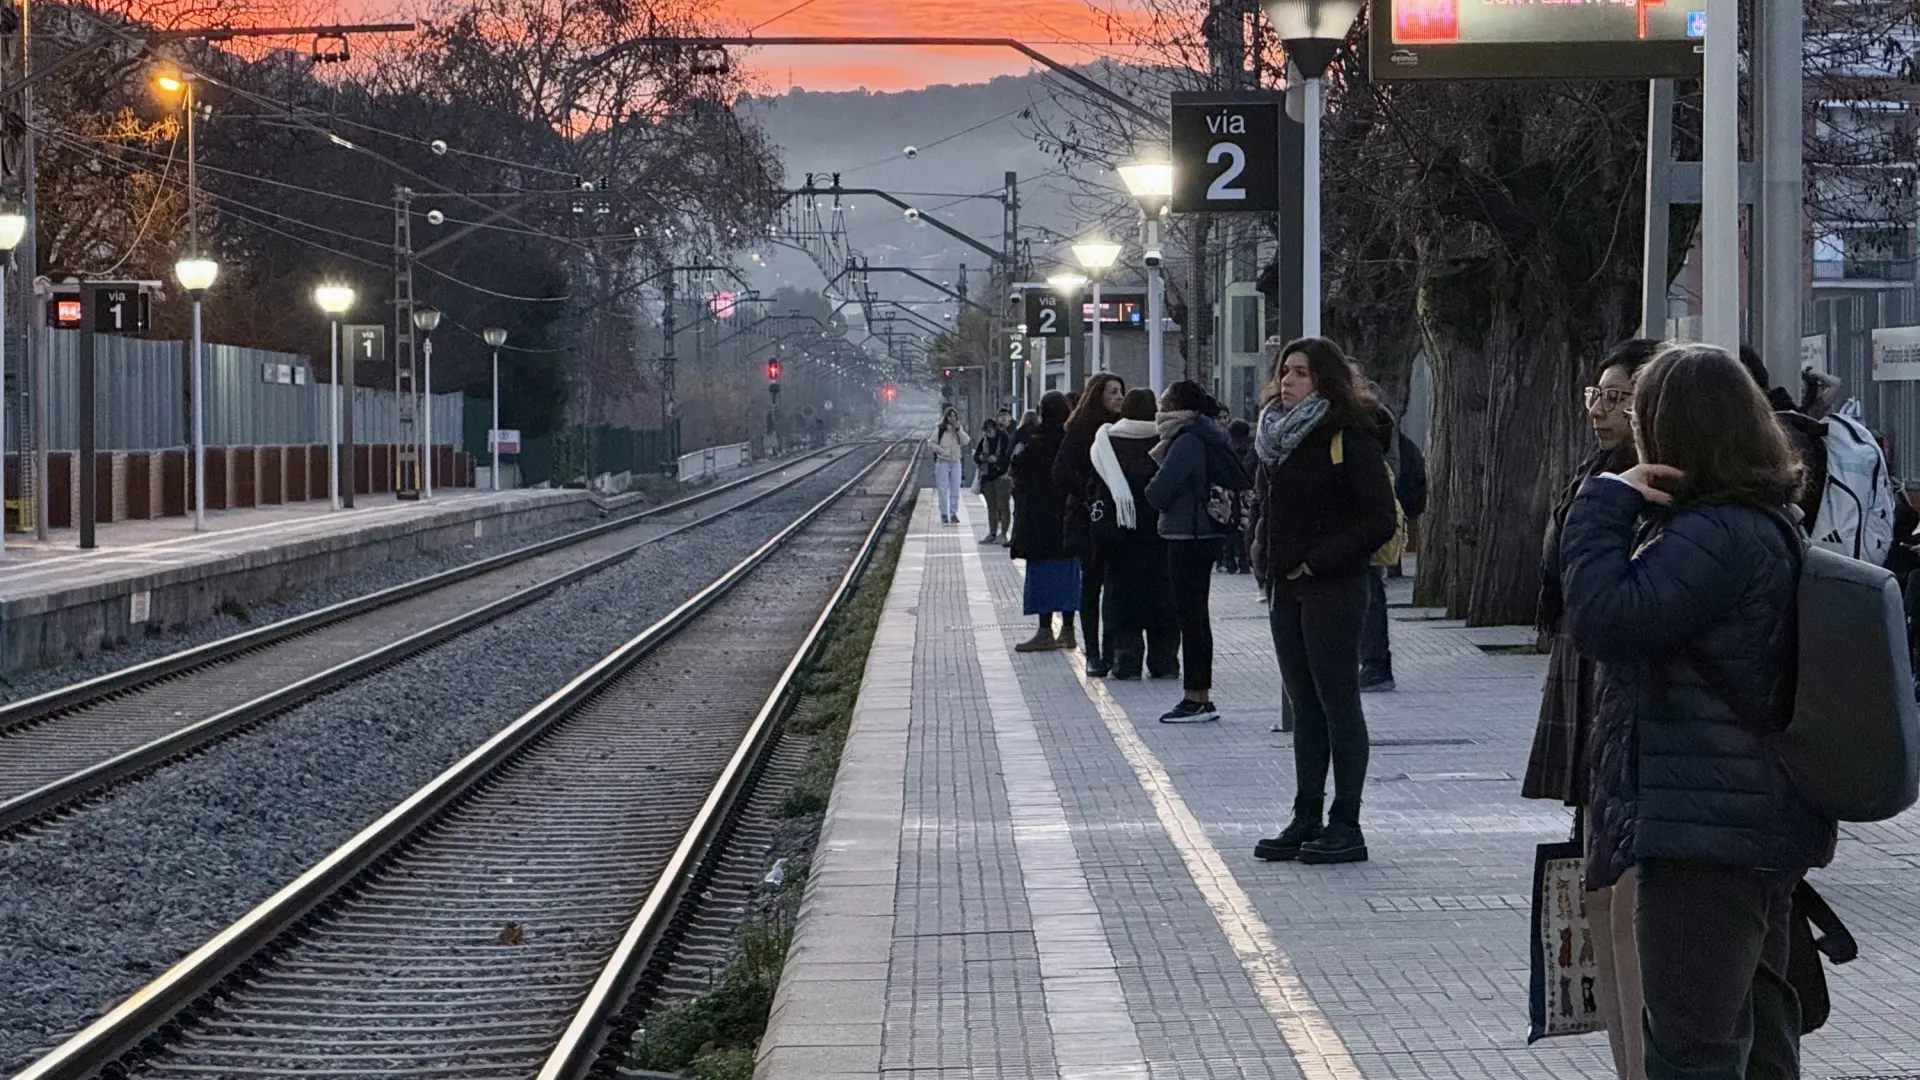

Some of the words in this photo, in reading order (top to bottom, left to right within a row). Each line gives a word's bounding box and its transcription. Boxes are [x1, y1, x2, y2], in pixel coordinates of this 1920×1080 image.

[1205, 108, 1246, 134] via
[1206, 141, 1246, 200] 2
[108, 290, 126, 301] via
[1039, 295, 1057, 306] via
[109, 303, 122, 329] 1
[1039, 308, 1057, 333] 2
[361, 330, 375, 339] via
[1009, 332, 1023, 341] via
[362, 339, 372, 358] 1
[1009, 341, 1023, 360] 2
